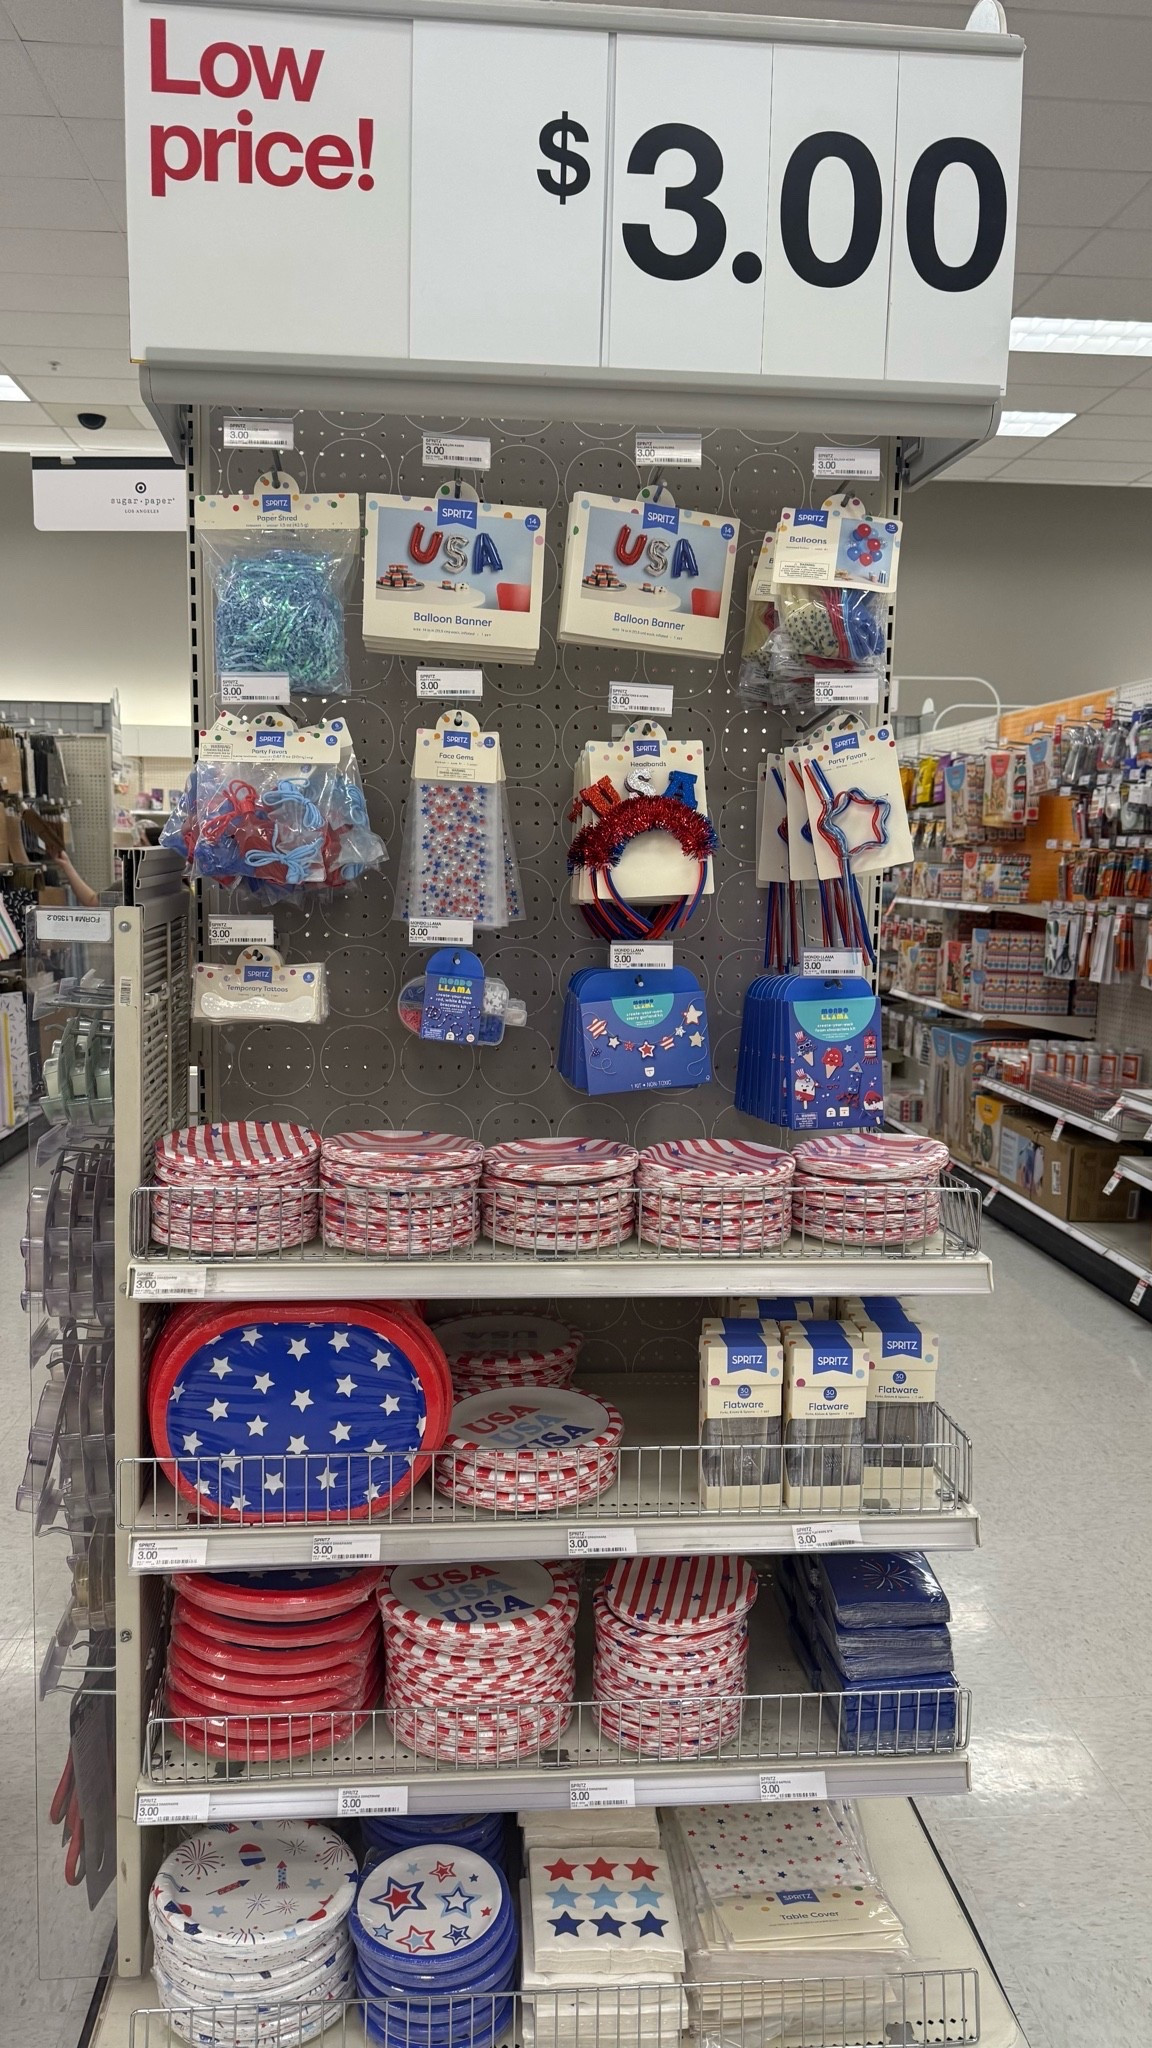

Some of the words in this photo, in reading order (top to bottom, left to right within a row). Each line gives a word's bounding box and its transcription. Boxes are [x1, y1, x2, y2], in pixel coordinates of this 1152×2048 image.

[150, 17, 324, 103] Low
[150, 110, 375, 197] price!
[230, 431, 248, 439] 3.00
[426, 446, 444, 454] 3.00
[637, 449, 655, 457] 3.00
[818, 461, 836, 469] 3.00
[257, 515, 276, 523] Paper
[278, 514, 298, 522] Shred
[442, 508, 472, 520] SPRITZ
[647, 512, 675, 525] SPRITZ
[798, 513, 824, 523] SPRITZ
[789, 536, 828, 545] Balloons
[408, 522, 503, 575] USA
[615, 524, 699, 579] USA
[413, 612, 452, 624] Balloon
[455, 615, 492, 627] Banner
[614, 612, 649, 626] Balloon
[651, 617, 685, 631] Banner
[420, 682, 438, 690] 3.00
[223, 688, 242, 696] 3.00
[612, 697, 630, 705] 3.00
[446, 736, 468, 744] SPRITZ
[835, 738, 856, 748] SPRITZ
[828, 758, 845, 766] Party
[846, 752, 867, 761] Favors
[47, 914, 74, 922] L1350.2
[75, 915, 100, 923] FORM#
[212, 930, 230, 938] 3.00
[410, 928, 428, 936] 3.00
[614, 955, 631, 963] 3.00
[804, 962, 821, 970] 3.00
[248, 970, 270, 978] SPRITZ
[227, 985, 262, 993] Temporary
[438, 984, 471, 994] LLAMA
[136, 1280, 156, 1289] 3.00
[886, 1341, 918, 1350] SPRITZ
[732, 1355, 763, 1365] SPRITZ
[817, 1357, 848, 1366] SPRITZ
[878, 1386, 918, 1394] Flatware
[723, 1401, 764, 1409] Flatware
[809, 1402, 849, 1411] Flatware
[461, 1404, 541, 1436] USA
[485, 1412, 567, 1446] USA
[569, 1539, 588, 1548] 3.00
[798, 1535, 817, 1544] 3.00
[313, 1545, 333, 1554] 3.00
[137, 1551, 158, 1560] 3.00
[408, 1564, 499, 1591] USA
[424, 1579, 517, 1608] USA
[439, 1594, 535, 1623] USA
[762, 1784, 780, 1794] 3.00
[571, 1791, 590, 1801] 3.00
[342, 1798, 361, 1808] 3.00
[139, 1807, 159, 1816] 3.00
[782, 1893, 813, 1902] SPRITZ
[780, 1913, 809, 1922] Table
[811, 1911, 839, 1919] Cover
